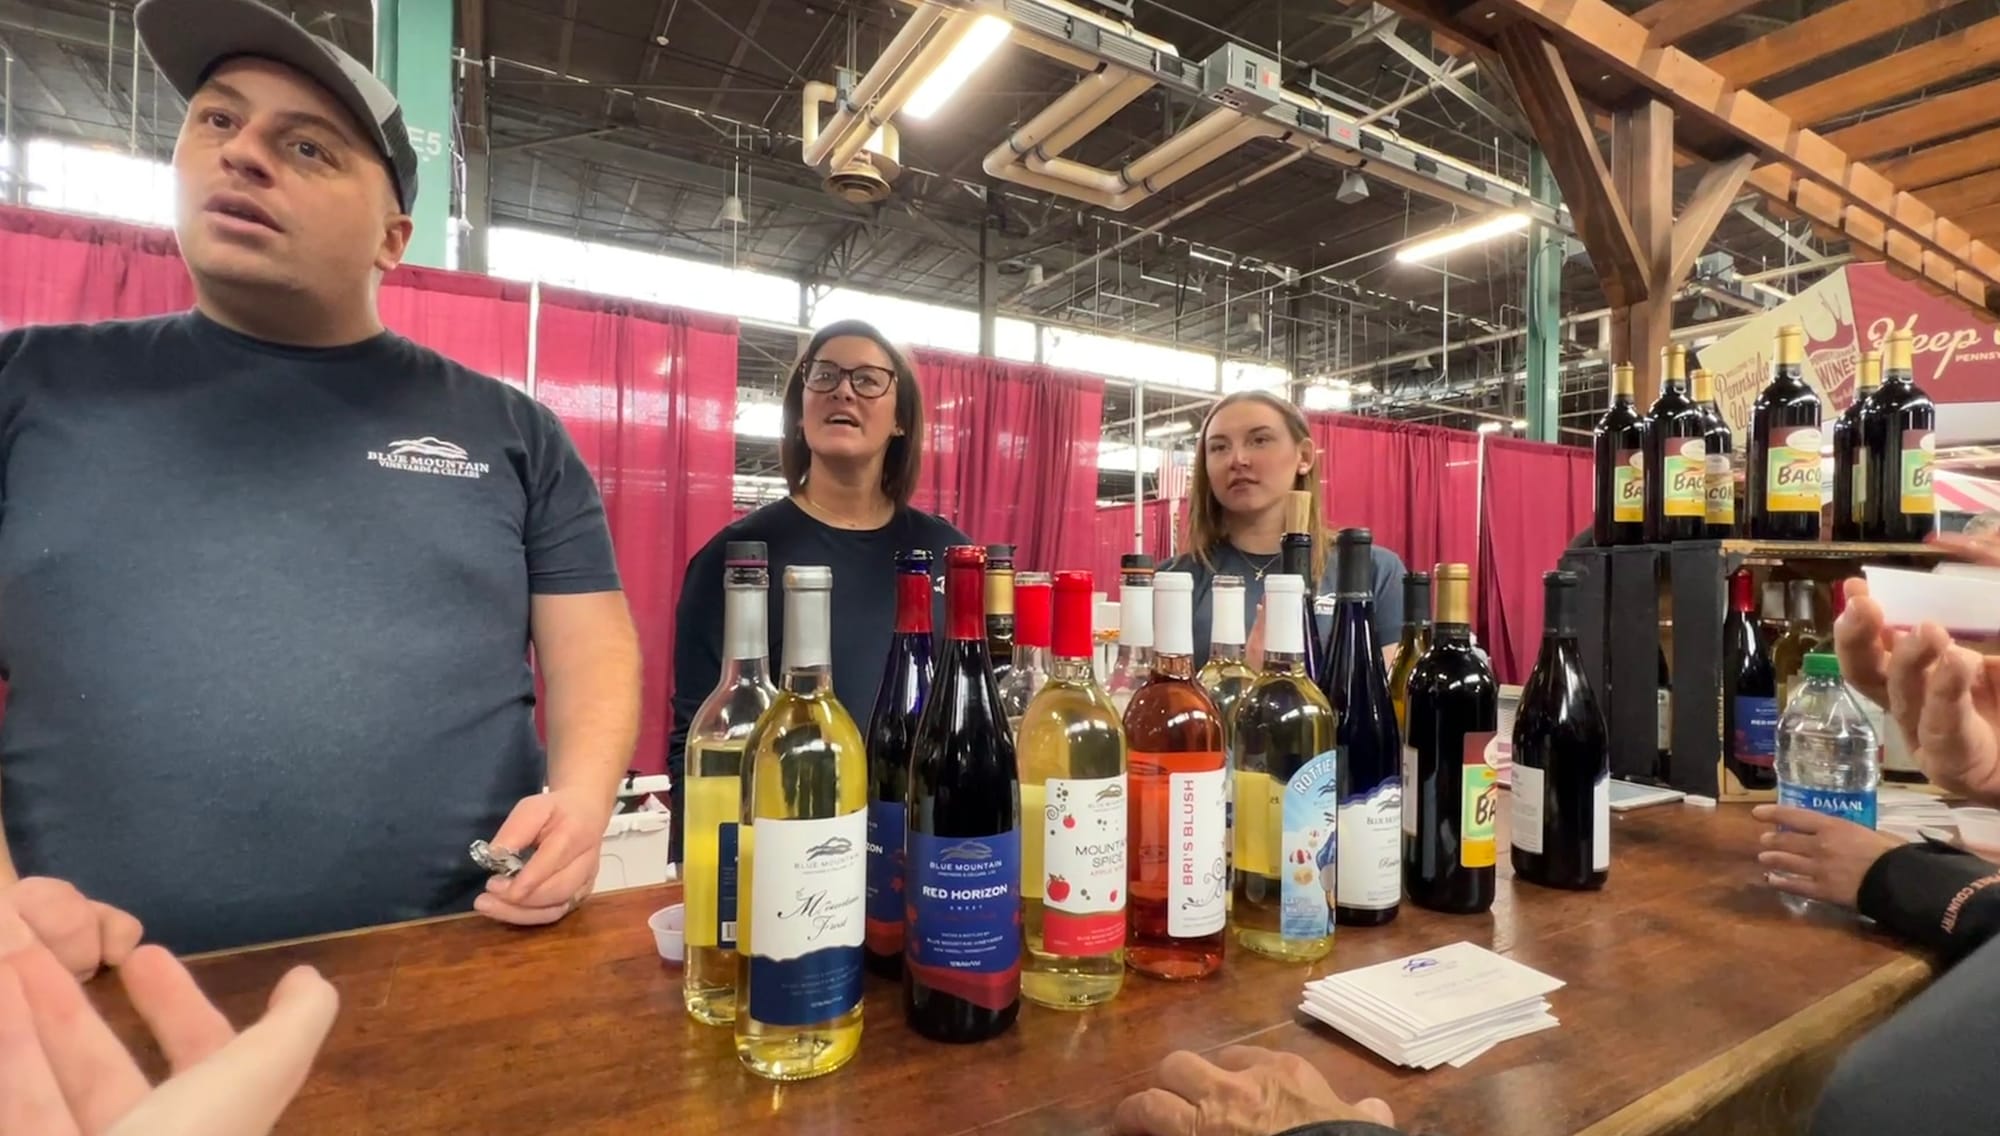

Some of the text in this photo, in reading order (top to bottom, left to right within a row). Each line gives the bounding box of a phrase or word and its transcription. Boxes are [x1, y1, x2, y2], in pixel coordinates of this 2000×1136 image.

[1815, 355, 1857, 391] WINES
[367, 451, 490, 473] BLUE MOUNTAIN
[1812, 796, 1864, 811] DASANI
[1182, 779, 1194, 886] BRI'S BLUSH
[929, 860, 1003, 871] BLUE MOUNTAIN
[922, 883, 1008, 900] RED HORIZON
